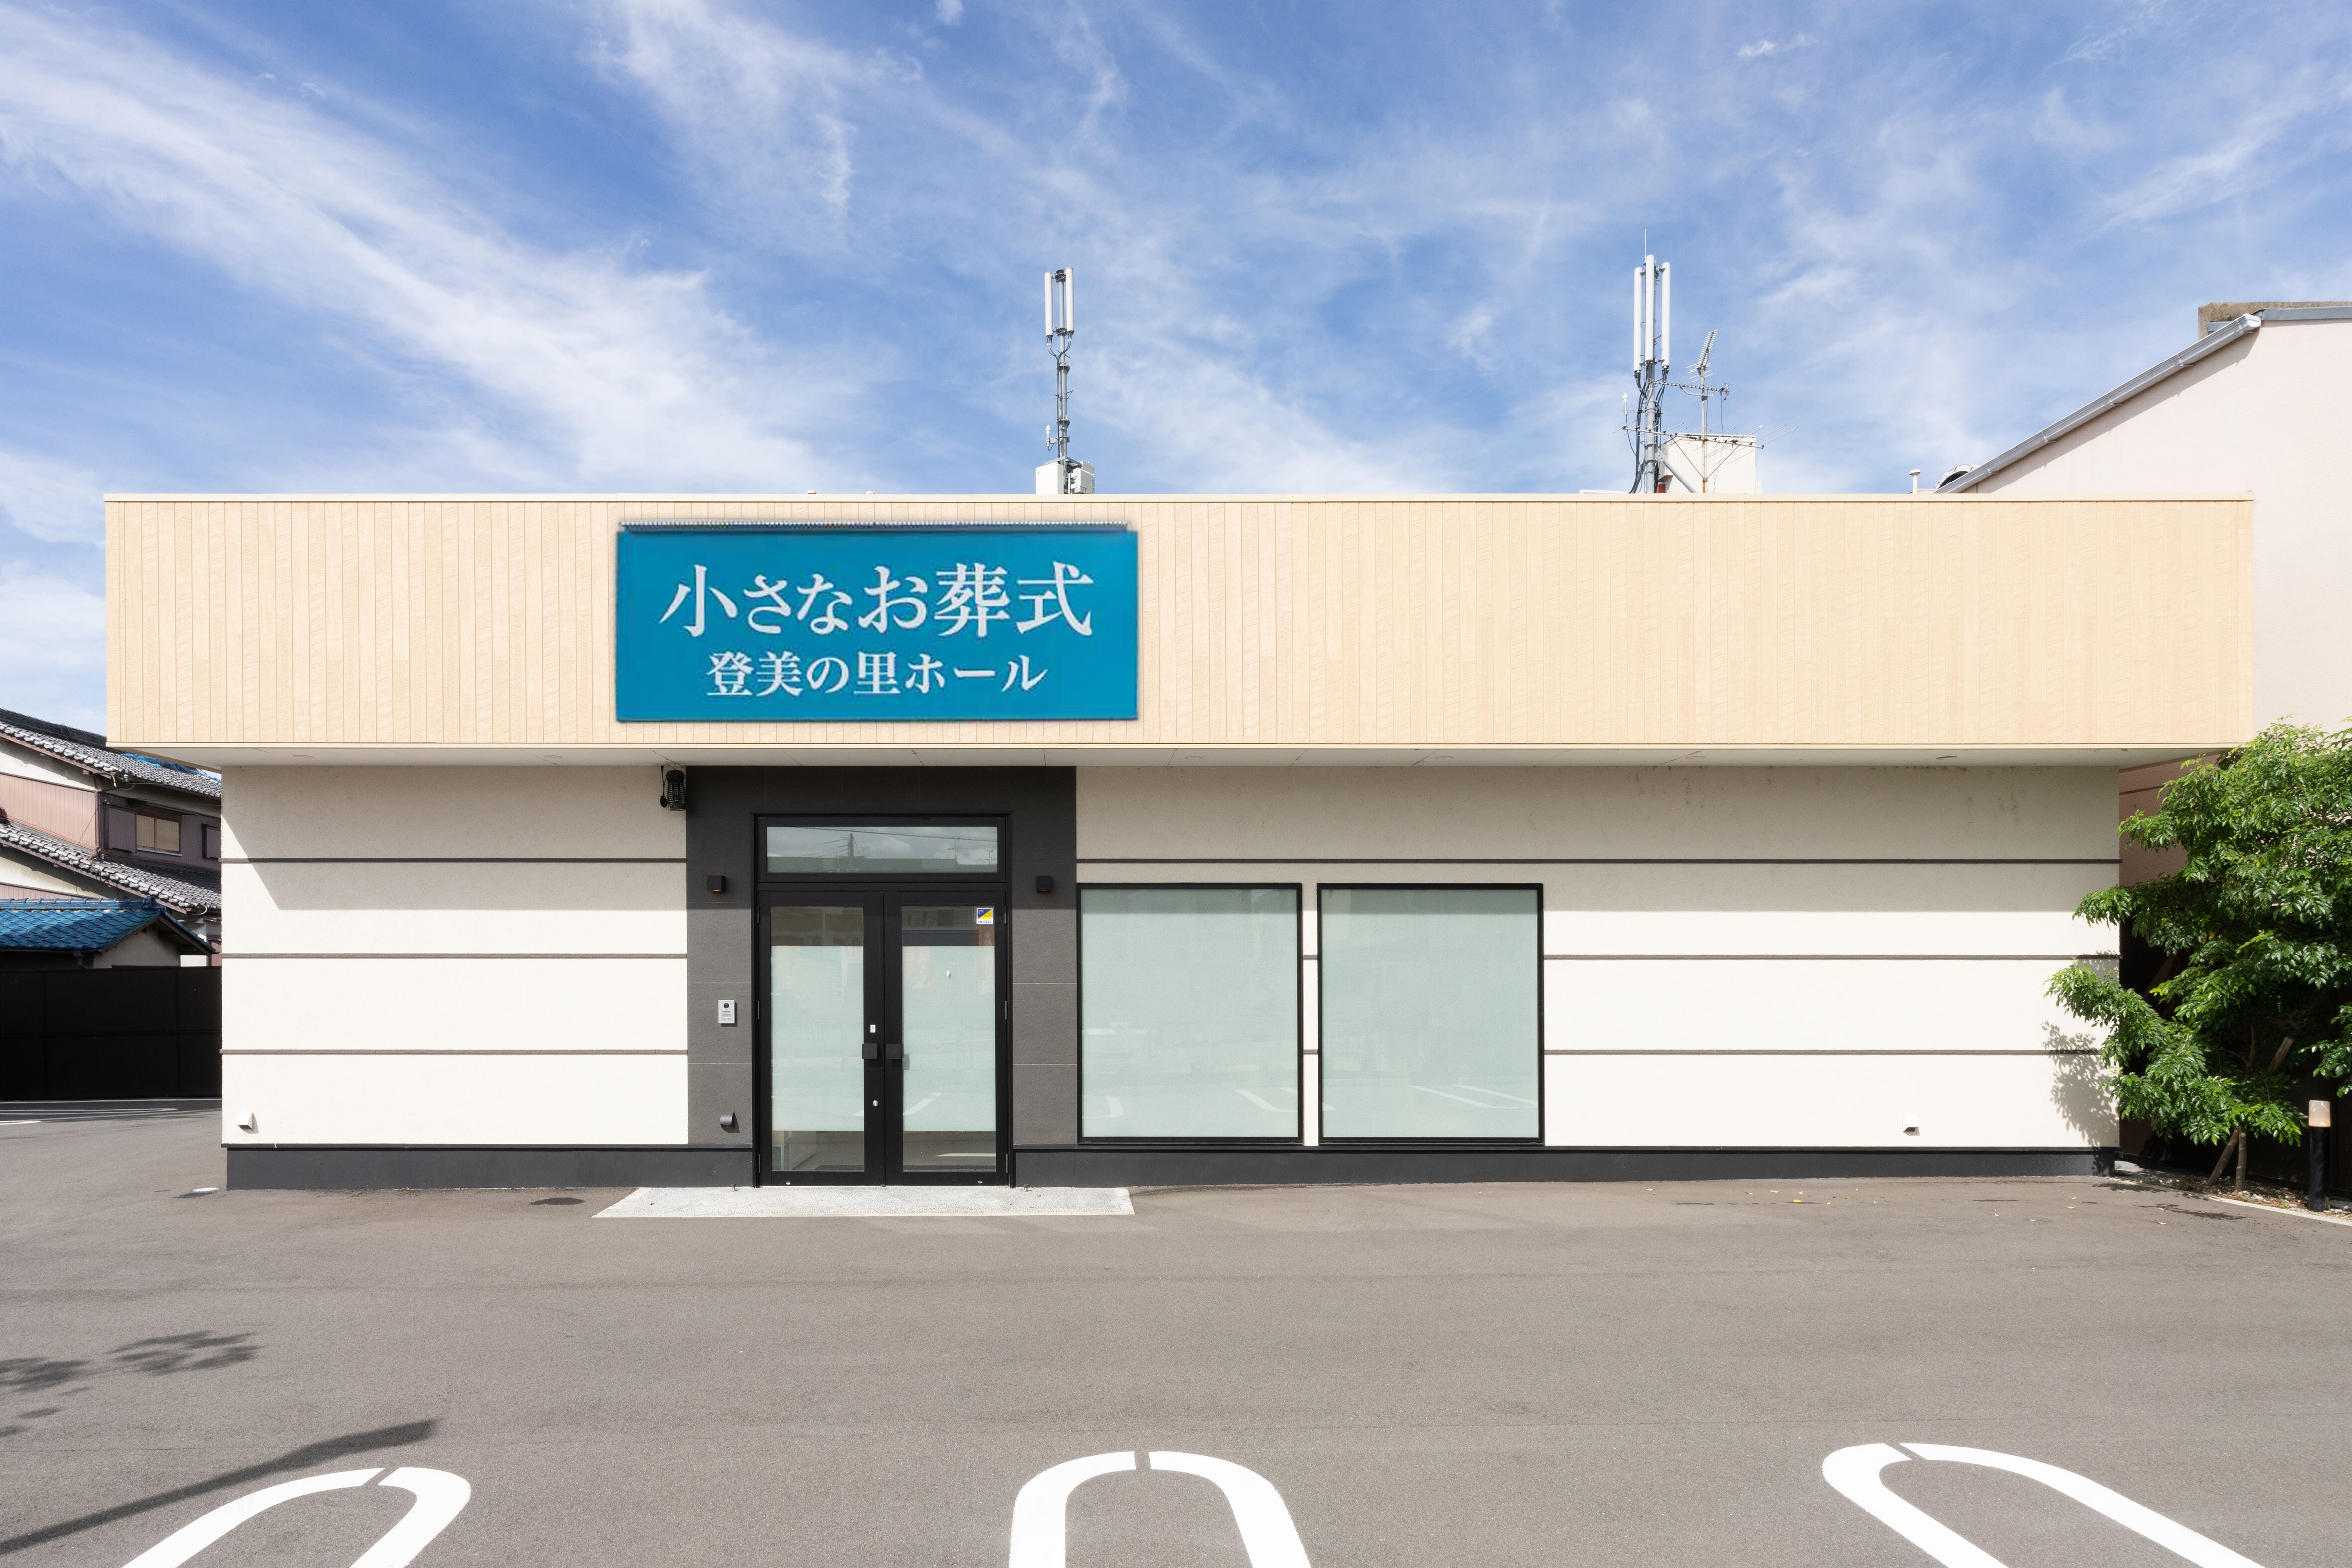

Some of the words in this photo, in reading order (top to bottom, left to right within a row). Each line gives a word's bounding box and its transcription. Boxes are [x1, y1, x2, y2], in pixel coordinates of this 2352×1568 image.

[660, 561, 1094, 637] 小さなお葬式
[706, 651, 1047, 696] 登美の里ホール
